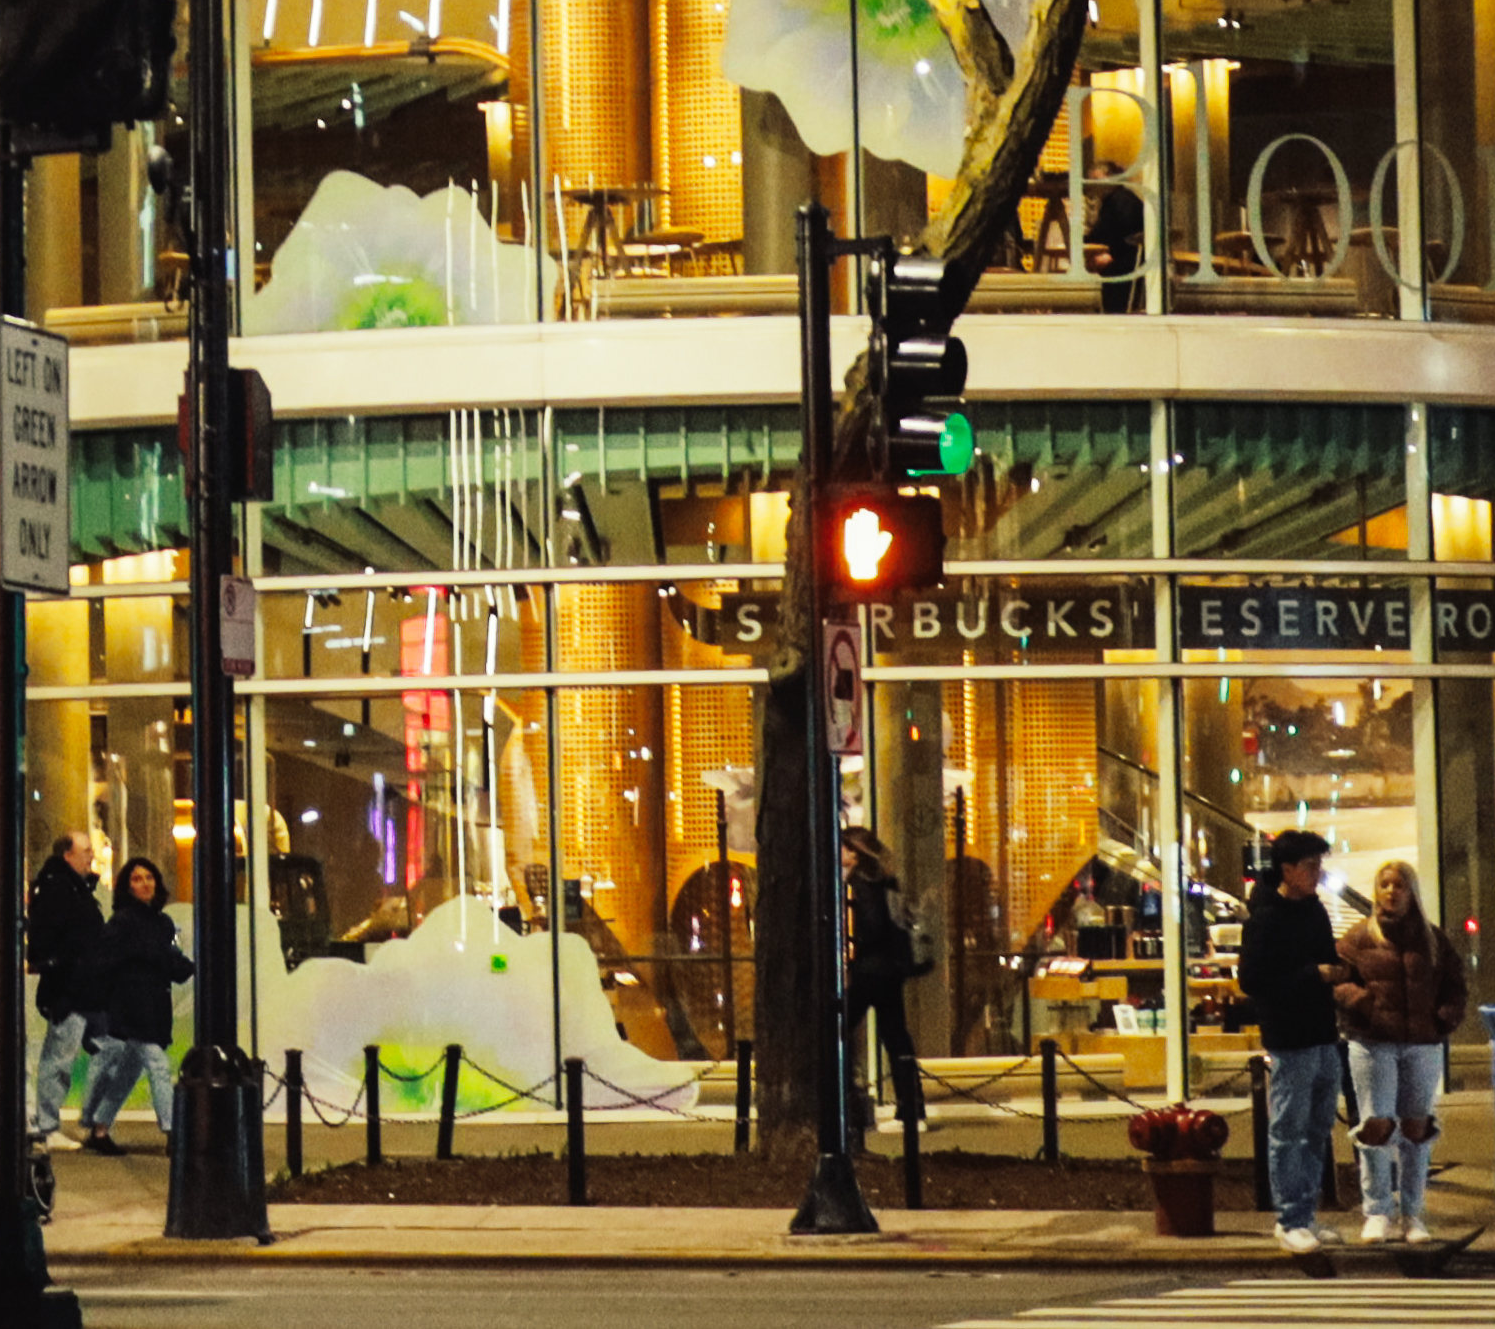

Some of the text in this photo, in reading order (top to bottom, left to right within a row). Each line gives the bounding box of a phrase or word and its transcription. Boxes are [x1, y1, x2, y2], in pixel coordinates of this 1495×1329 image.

[8, 346, 61, 394] LEFT ON
[13, 404, 56, 449] GREEN
[13, 461, 57, 505] ARROW
[19, 518, 51, 560] ONLY
[735, 600, 1115, 642] SRBUCKS
[1175, 599, 1408, 639] ESERVE
